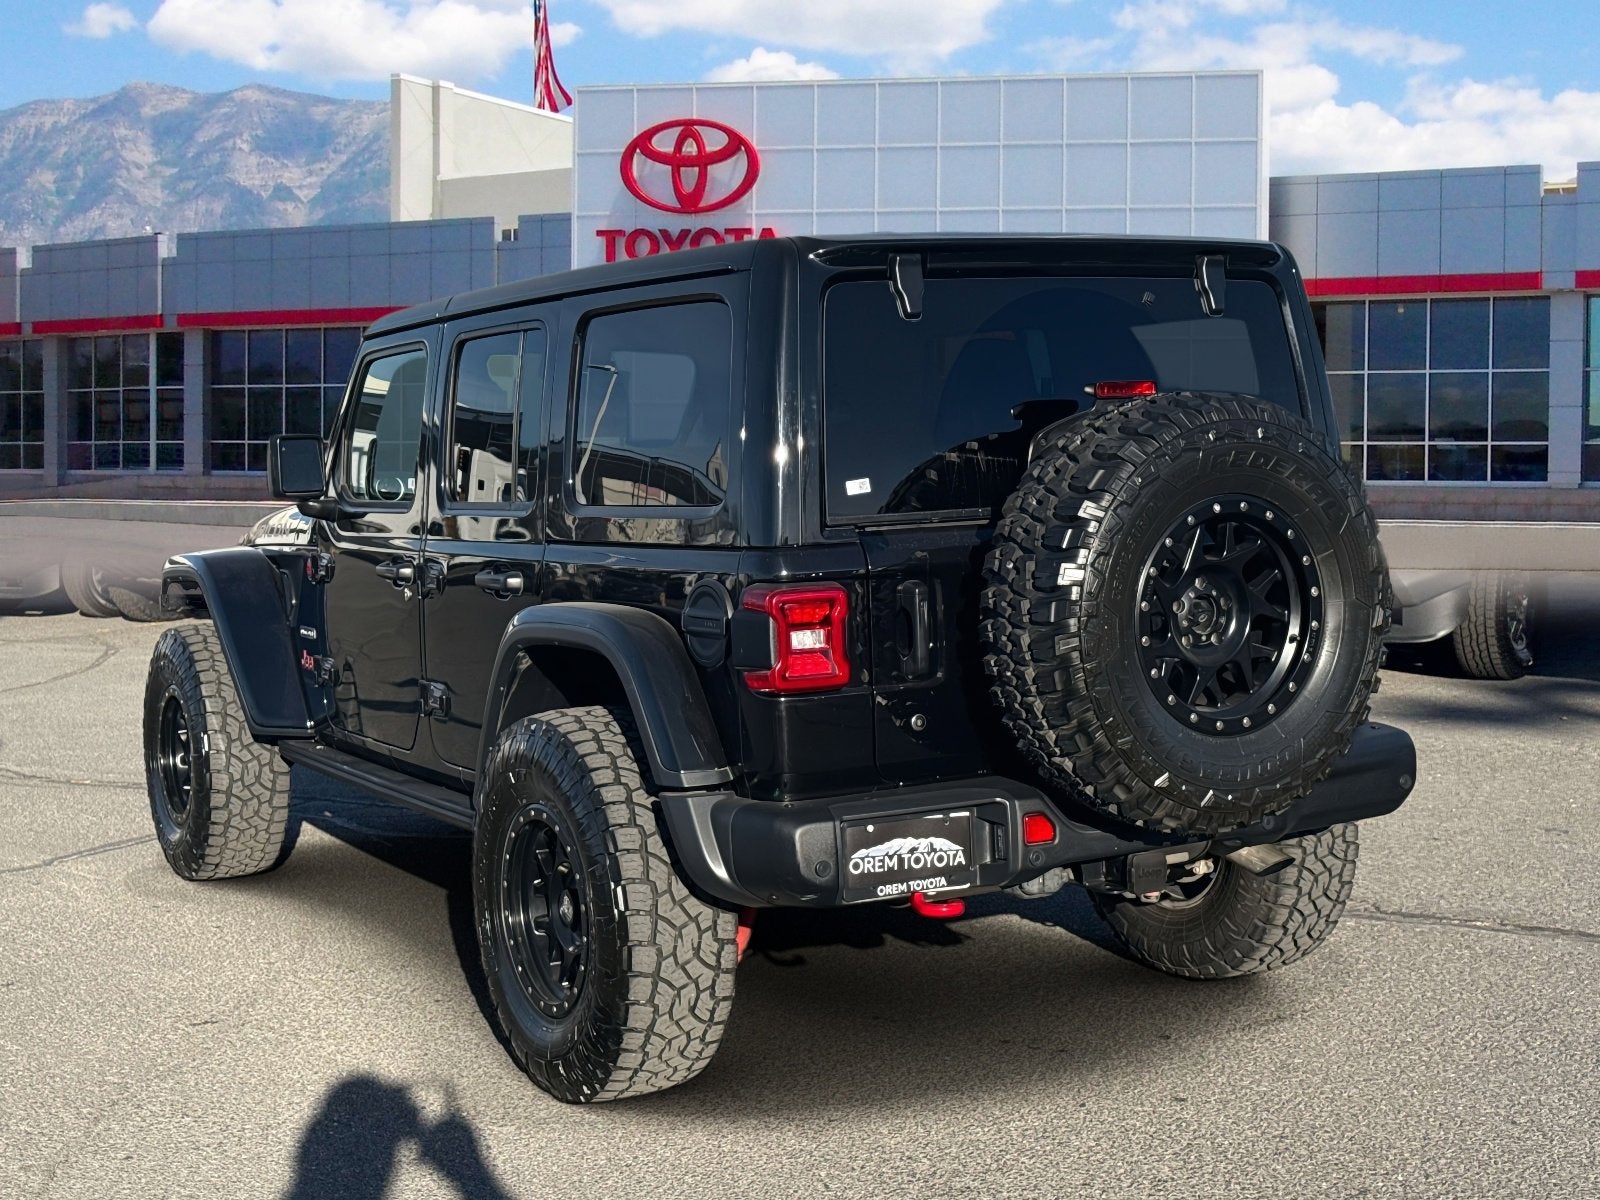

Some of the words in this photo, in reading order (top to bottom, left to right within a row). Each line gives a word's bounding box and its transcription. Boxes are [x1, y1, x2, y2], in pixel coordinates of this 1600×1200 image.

[849, 855, 898, 875] OREM
[902, 850, 966, 870] TOYOTA
[877, 883, 908, 897] OREM
[910, 877, 947, 892] TOYOTA
